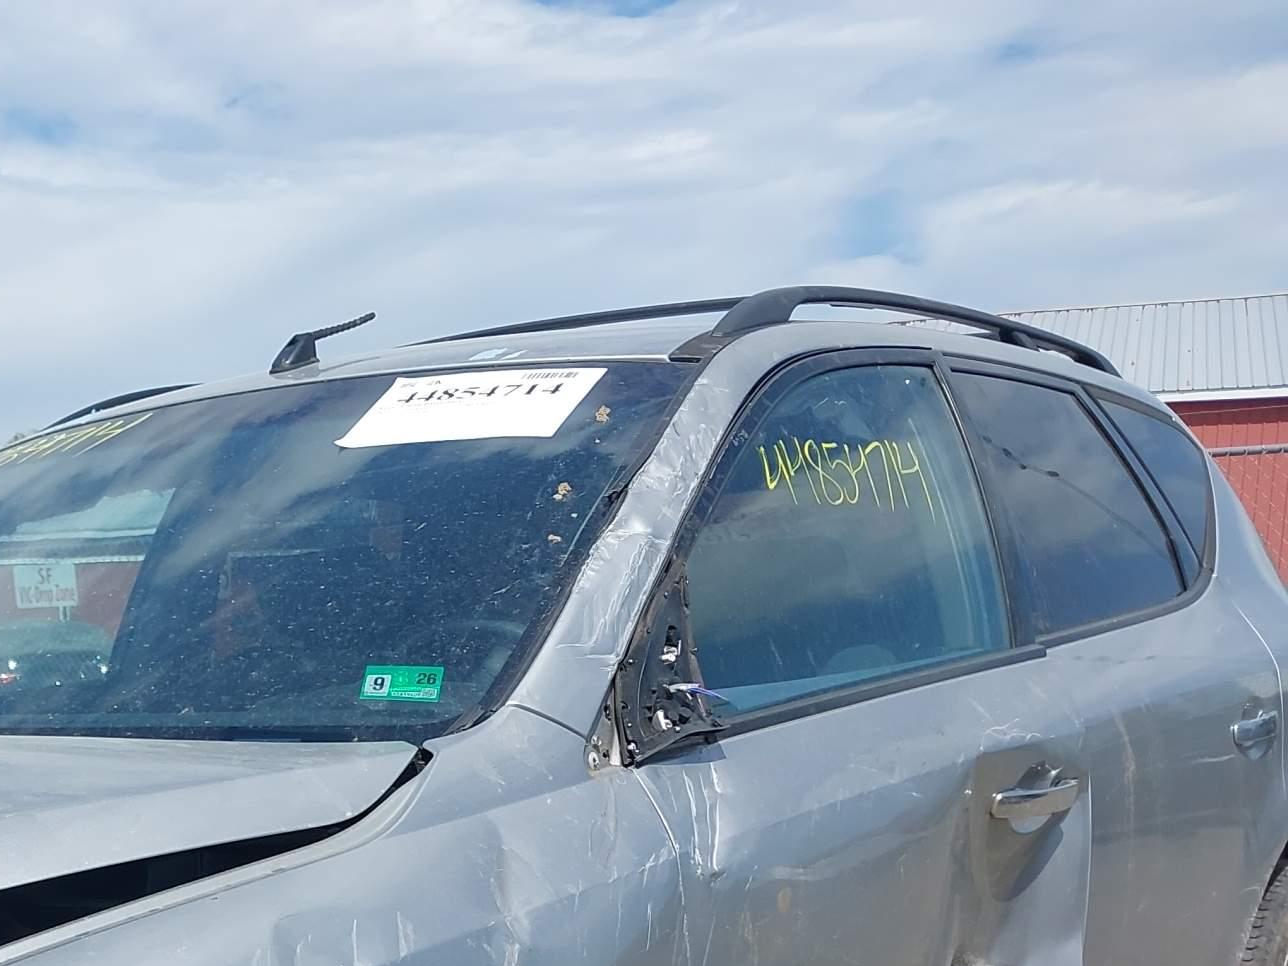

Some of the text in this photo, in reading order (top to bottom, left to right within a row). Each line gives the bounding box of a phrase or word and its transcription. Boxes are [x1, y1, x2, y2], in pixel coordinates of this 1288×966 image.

[397, 382, 565, 404] 44854714
[757, 436, 937, 524] 44854714
[372, 676, 385, 691] 9
[416, 672, 437, 685] 26
